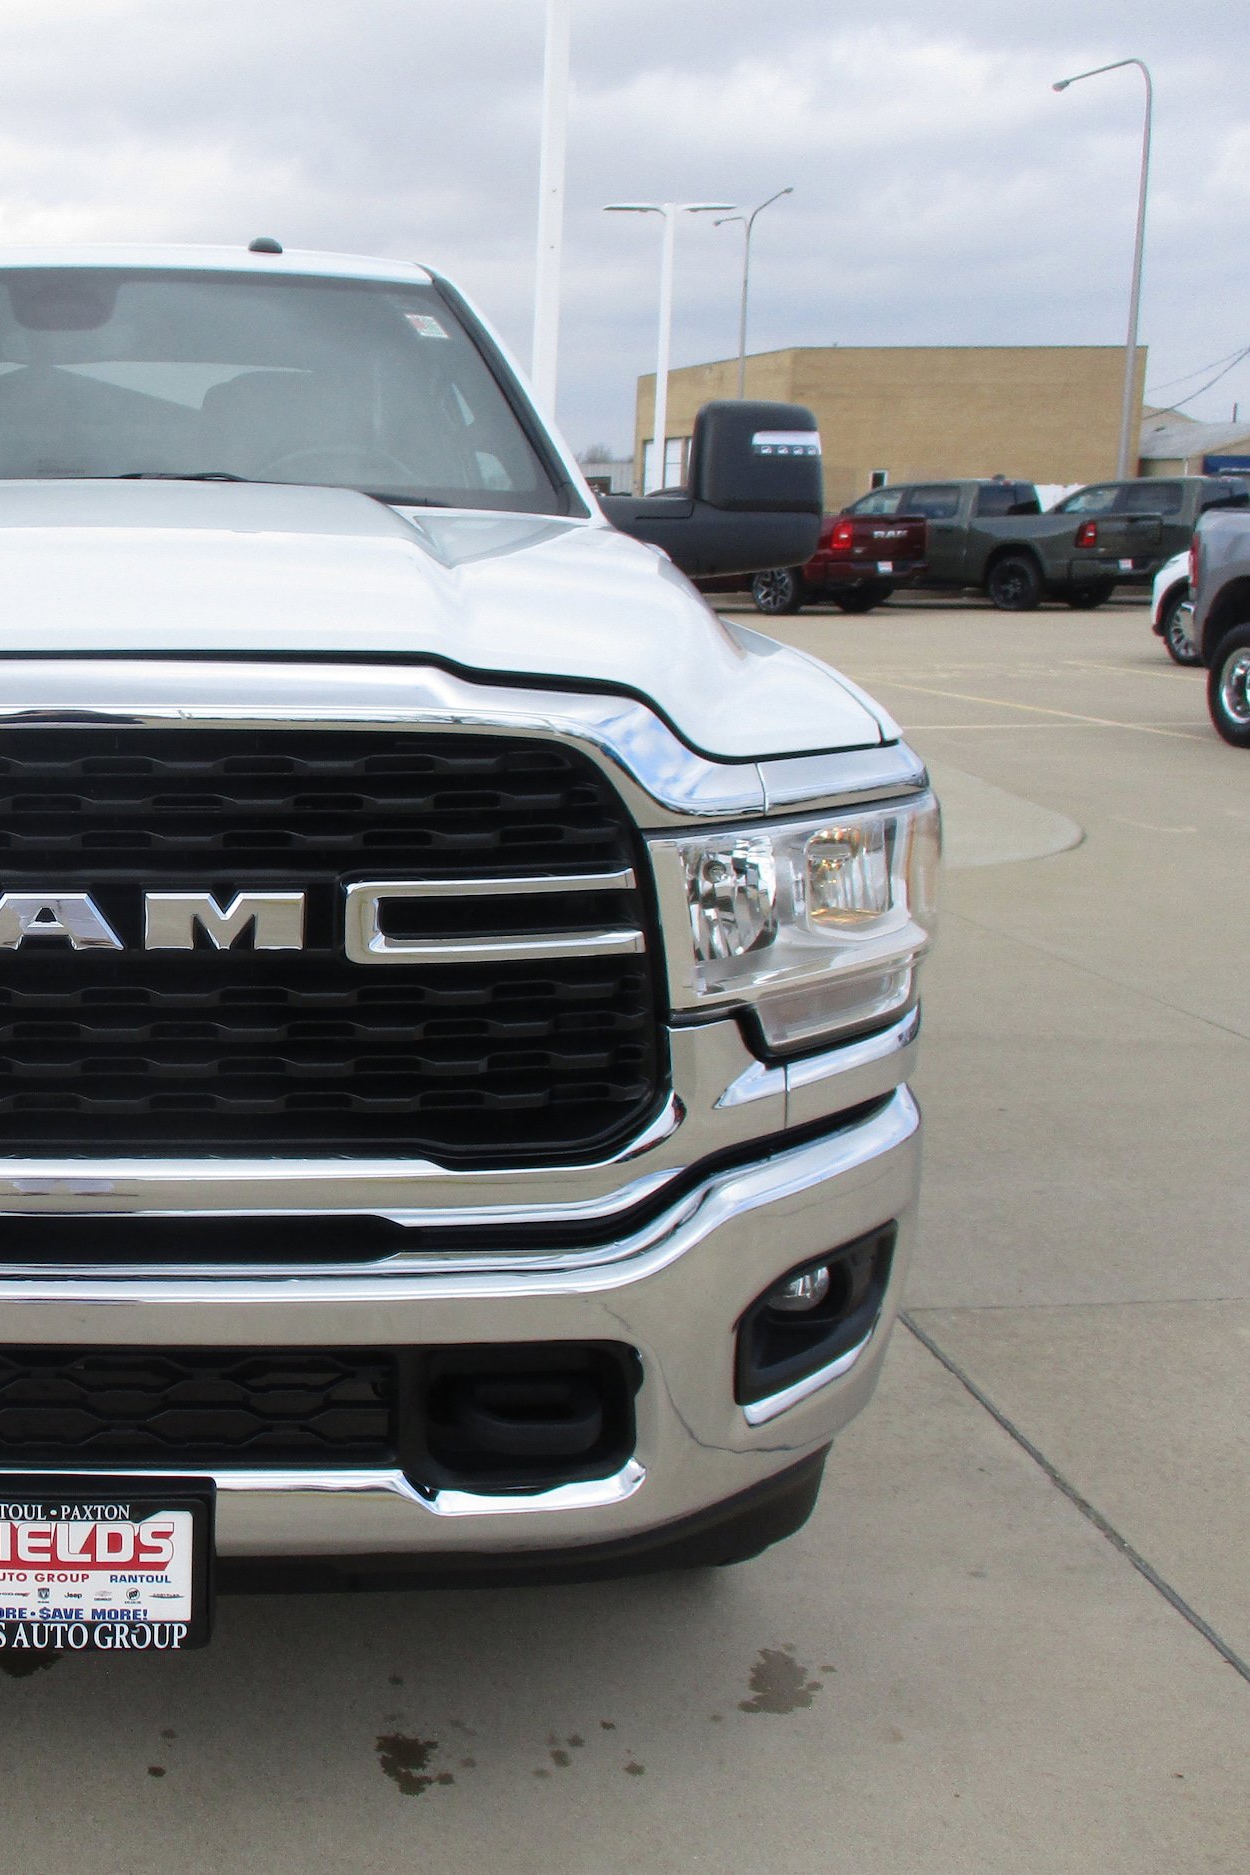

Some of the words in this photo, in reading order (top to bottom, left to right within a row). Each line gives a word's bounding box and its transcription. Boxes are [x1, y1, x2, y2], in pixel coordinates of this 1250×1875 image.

[872, 530, 908, 539] RAM
[61, 1504, 131, 1521] PAXTON
[35, 1572, 90, 1584] GROUP
[109, 1574, 172, 1584] RANTOUL
[39, 1607, 84, 1621] $AVE
[91, 1608, 148, 1621] MORE!
[12, 1622, 88, 1650] AUTO
[94, 1623, 188, 1651] GROUP
